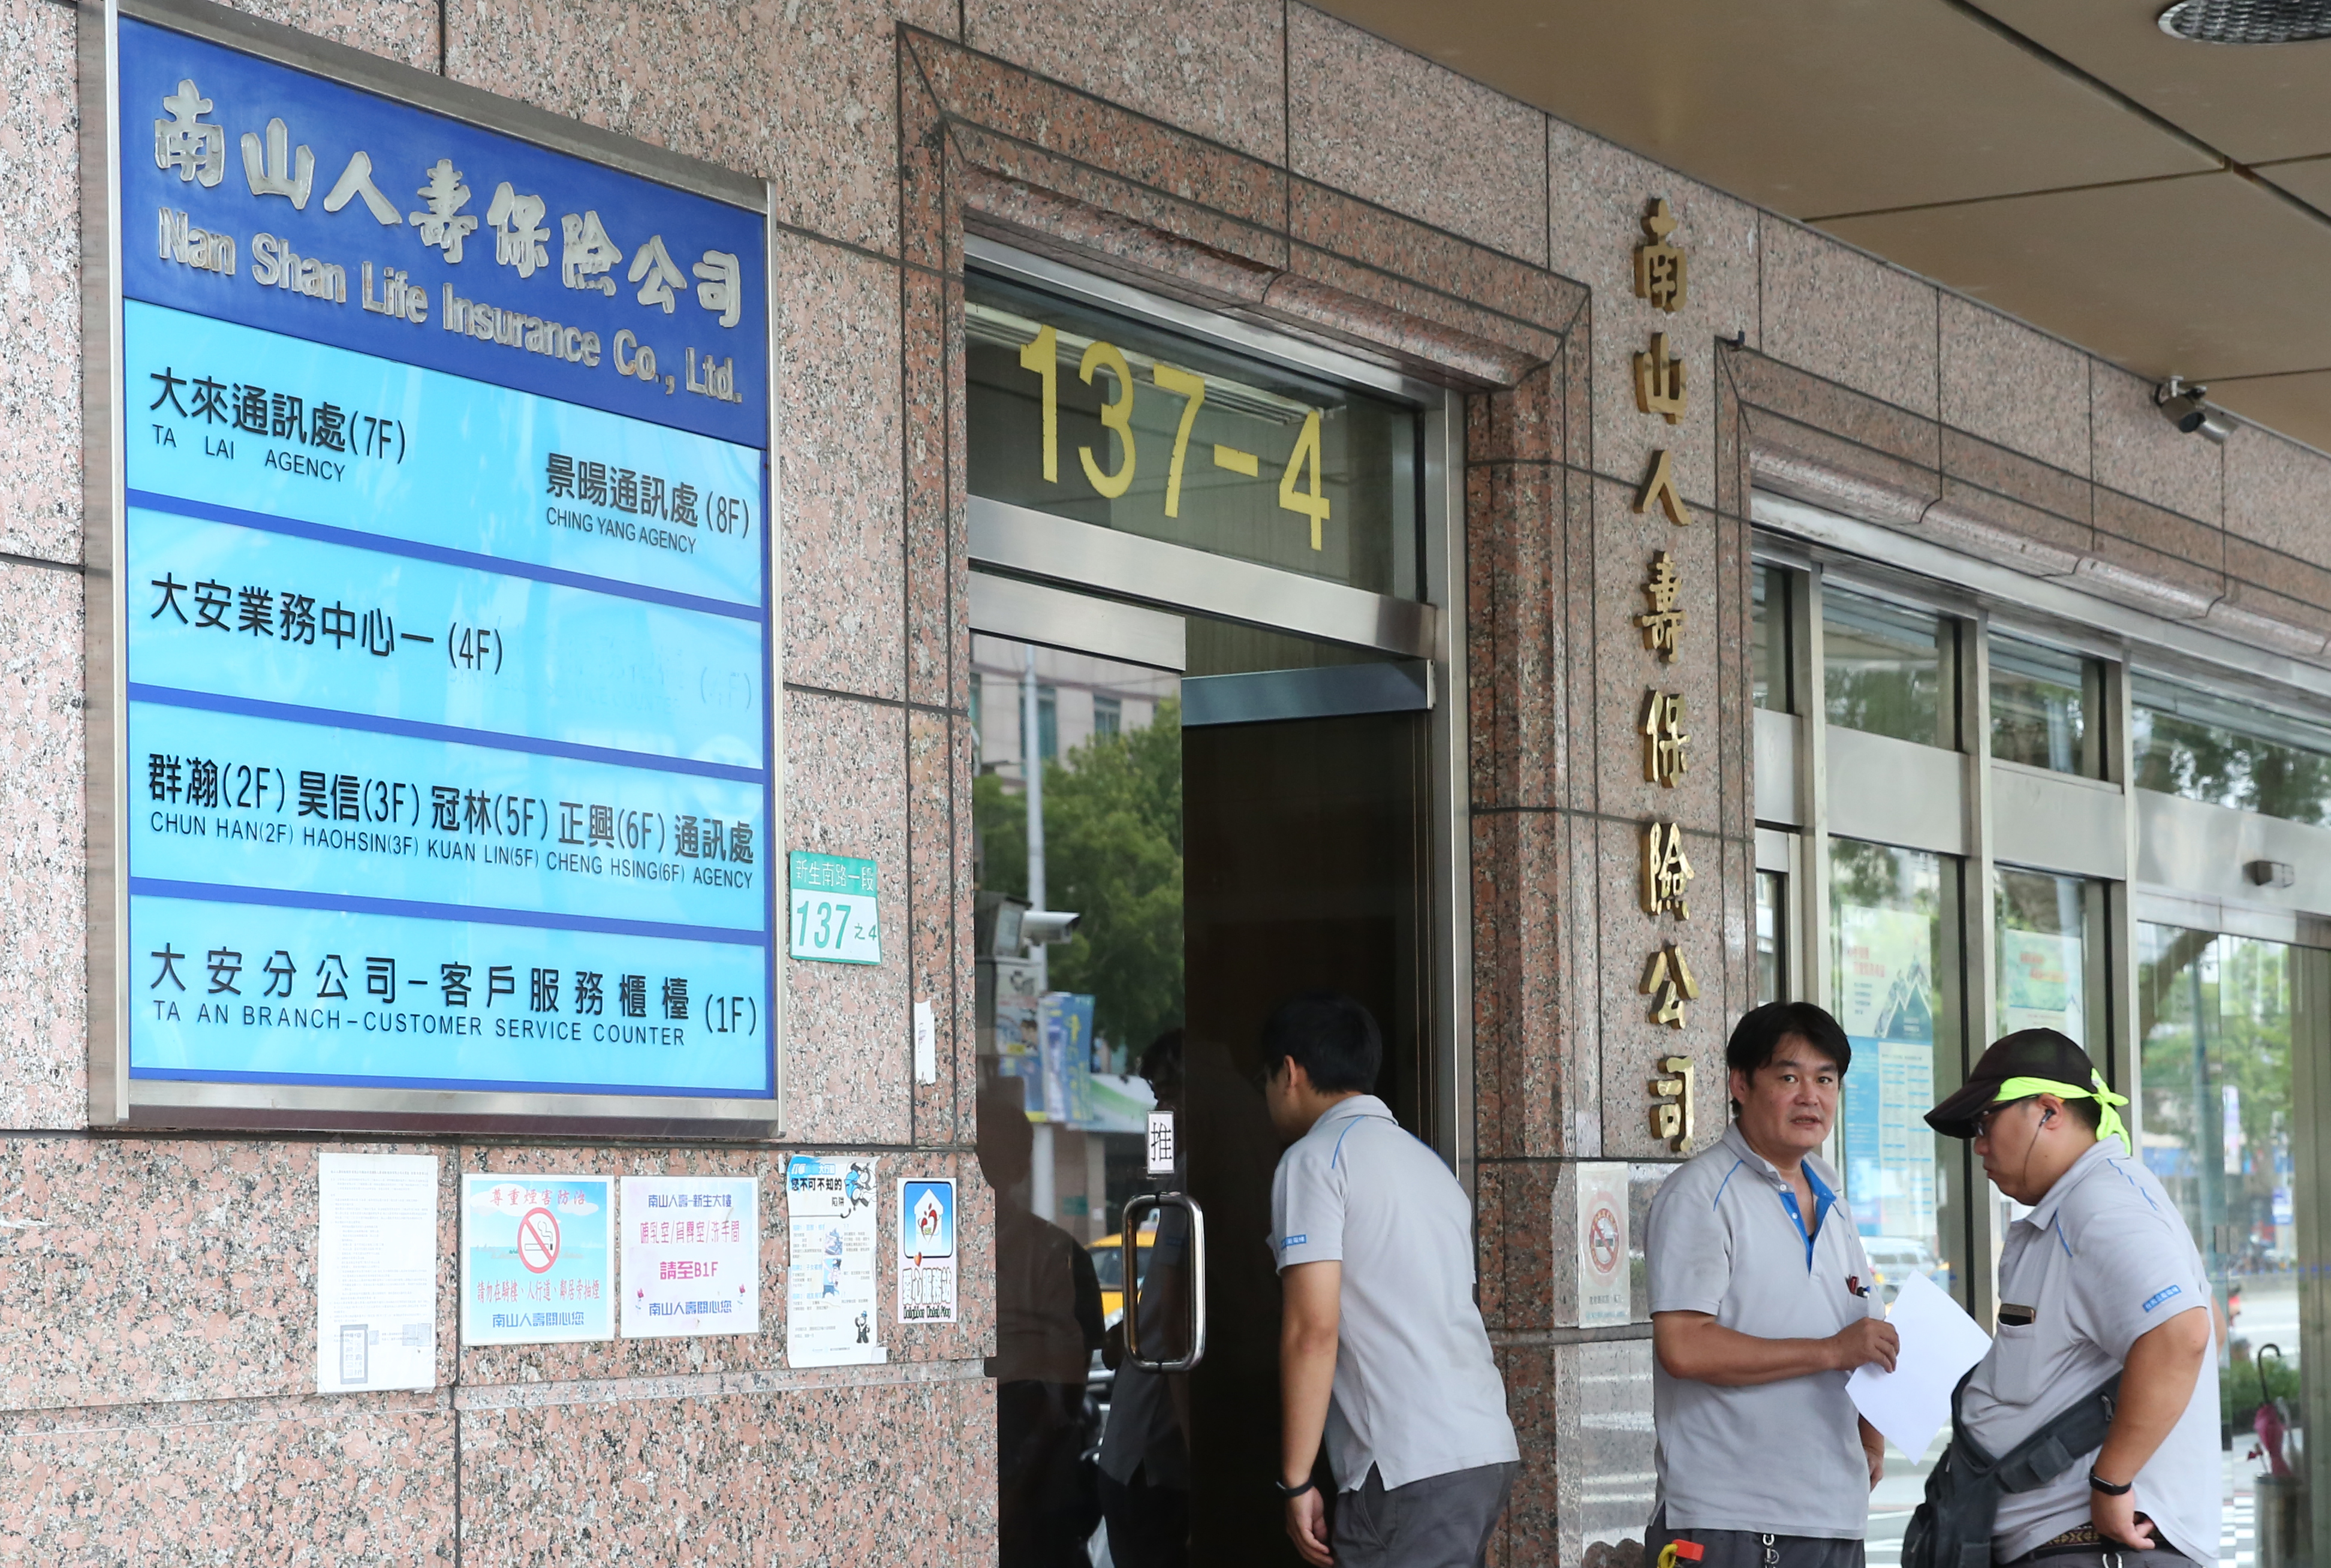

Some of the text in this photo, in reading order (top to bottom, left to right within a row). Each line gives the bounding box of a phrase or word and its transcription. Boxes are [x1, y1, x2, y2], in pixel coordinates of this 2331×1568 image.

[154, 79, 742, 328] 南山人壽保險公司
[159, 207, 742, 403] Nan Shan Life Insurance Co., Ltd.
[150, 367, 406, 464] 大來通訊處(7F)
[1020, 324, 1330, 551] 137-4
[152, 424, 345, 482] TA LAI AGENCY
[547, 506, 697, 554] CHING YANG AGENCY
[706, 491, 749, 539] (8F)
[448, 622, 503, 674] (4F)
[1634, 198, 1700, 1152] 南山人壽保險公司
[149, 753, 754, 864] 群瀚(2F) 昊信(3F) 冠林(5F) 正興(6F) 通訊處
[151, 811, 752, 888] CHUN HAN(2F) HAOHSIN(3F) KUAN LIN(5F) CHENG HSING(6F) AGENCY
[795, 858, 874, 892] 新生南路一段
[797, 900, 851, 950] 137
[153, 1000, 180, 1021] TA
[198, 1003, 228, 1024] AN
[496, 1018, 581, 1041] SERVICE
[594, 1023, 685, 1045] COUNTER
[706, 993, 756, 1036] (1F)
[1151, 1122, 1173, 1162] 推
[489, 1187, 586, 1207] 尊重煙害防治
[791, 1177, 842, 1192] 您不可不知的
[659, 1261, 719, 1280] 請至B1F
[492, 1310, 585, 1328] 南山人壽關心您
[649, 1299, 733, 1316] 南山人壽關心您
